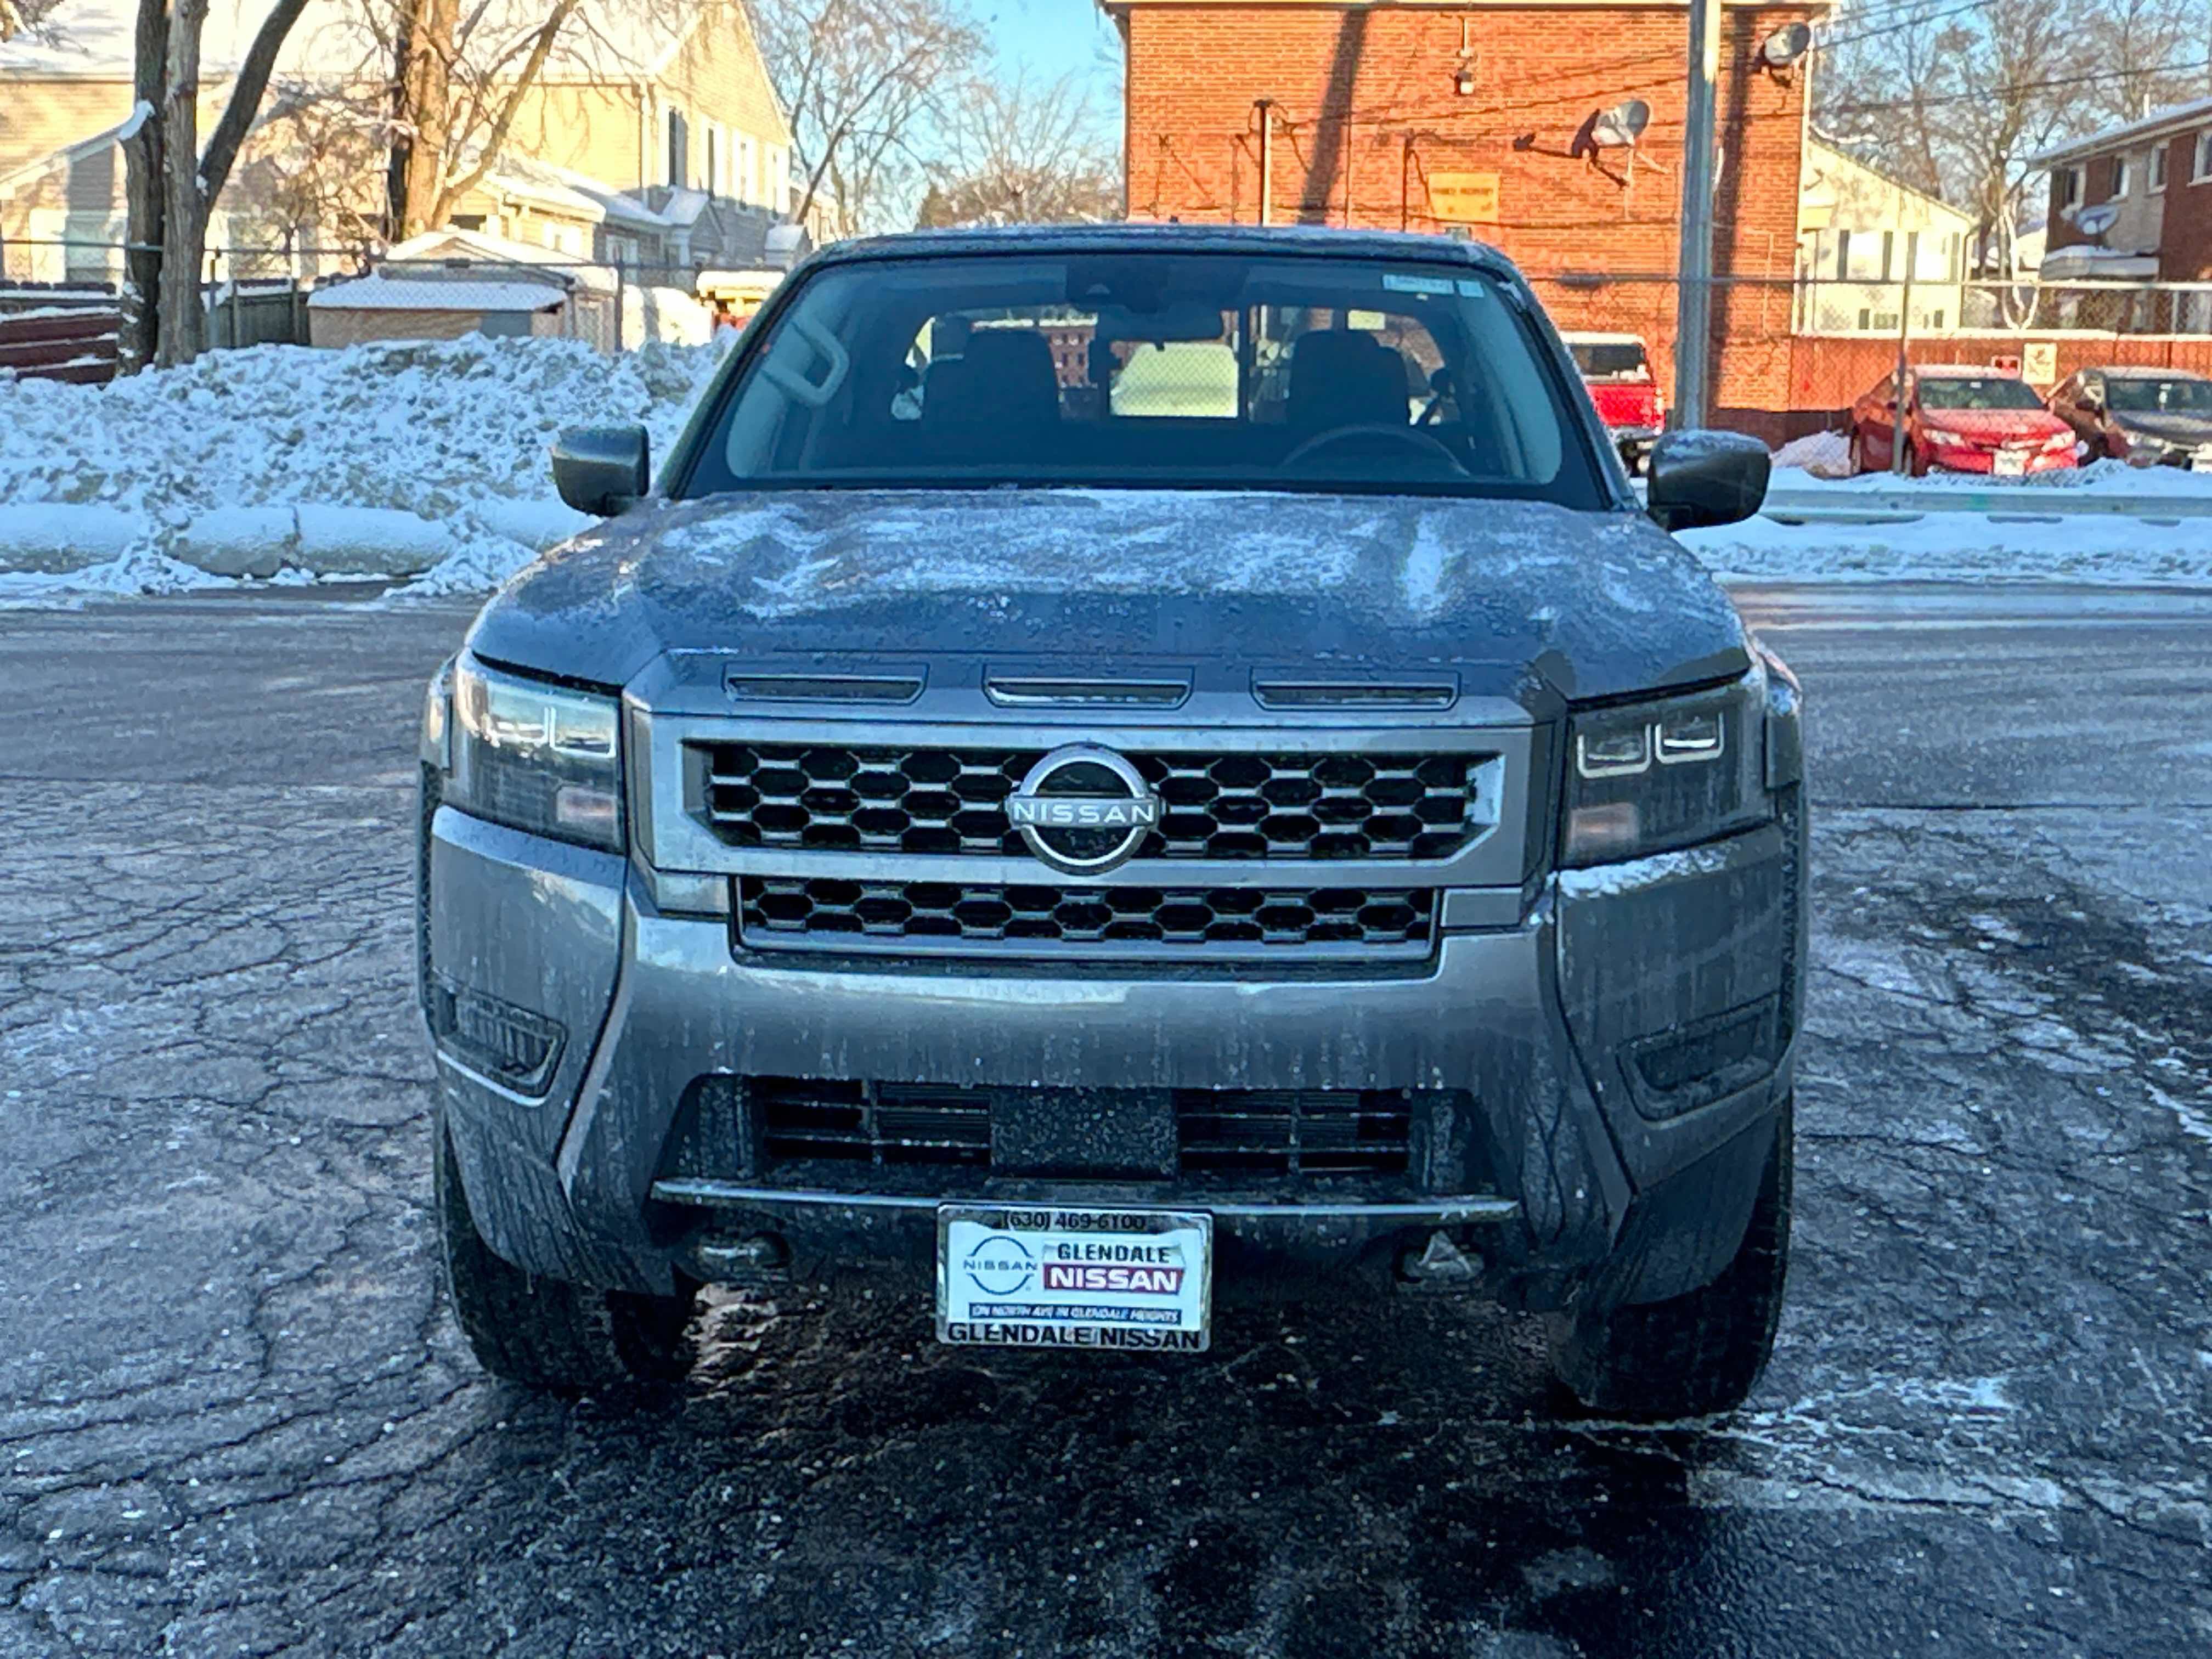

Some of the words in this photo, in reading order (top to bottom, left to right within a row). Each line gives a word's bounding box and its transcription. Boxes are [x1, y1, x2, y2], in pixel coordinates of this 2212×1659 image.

[1014, 803, 1153, 823] NISSAN
[1004, 1210, 1050, 1231] (630)
[1056, 1211, 1147, 1229] 469-6100
[1058, 1243, 1169, 1262] GLENDALE
[963, 1260, 1037, 1270] NISSAN
[1051, 1267, 1177, 1291] NISSAN
[947, 1323, 1092, 1345] GLENDALE
[1100, 1328, 1200, 1349] NISSAN
